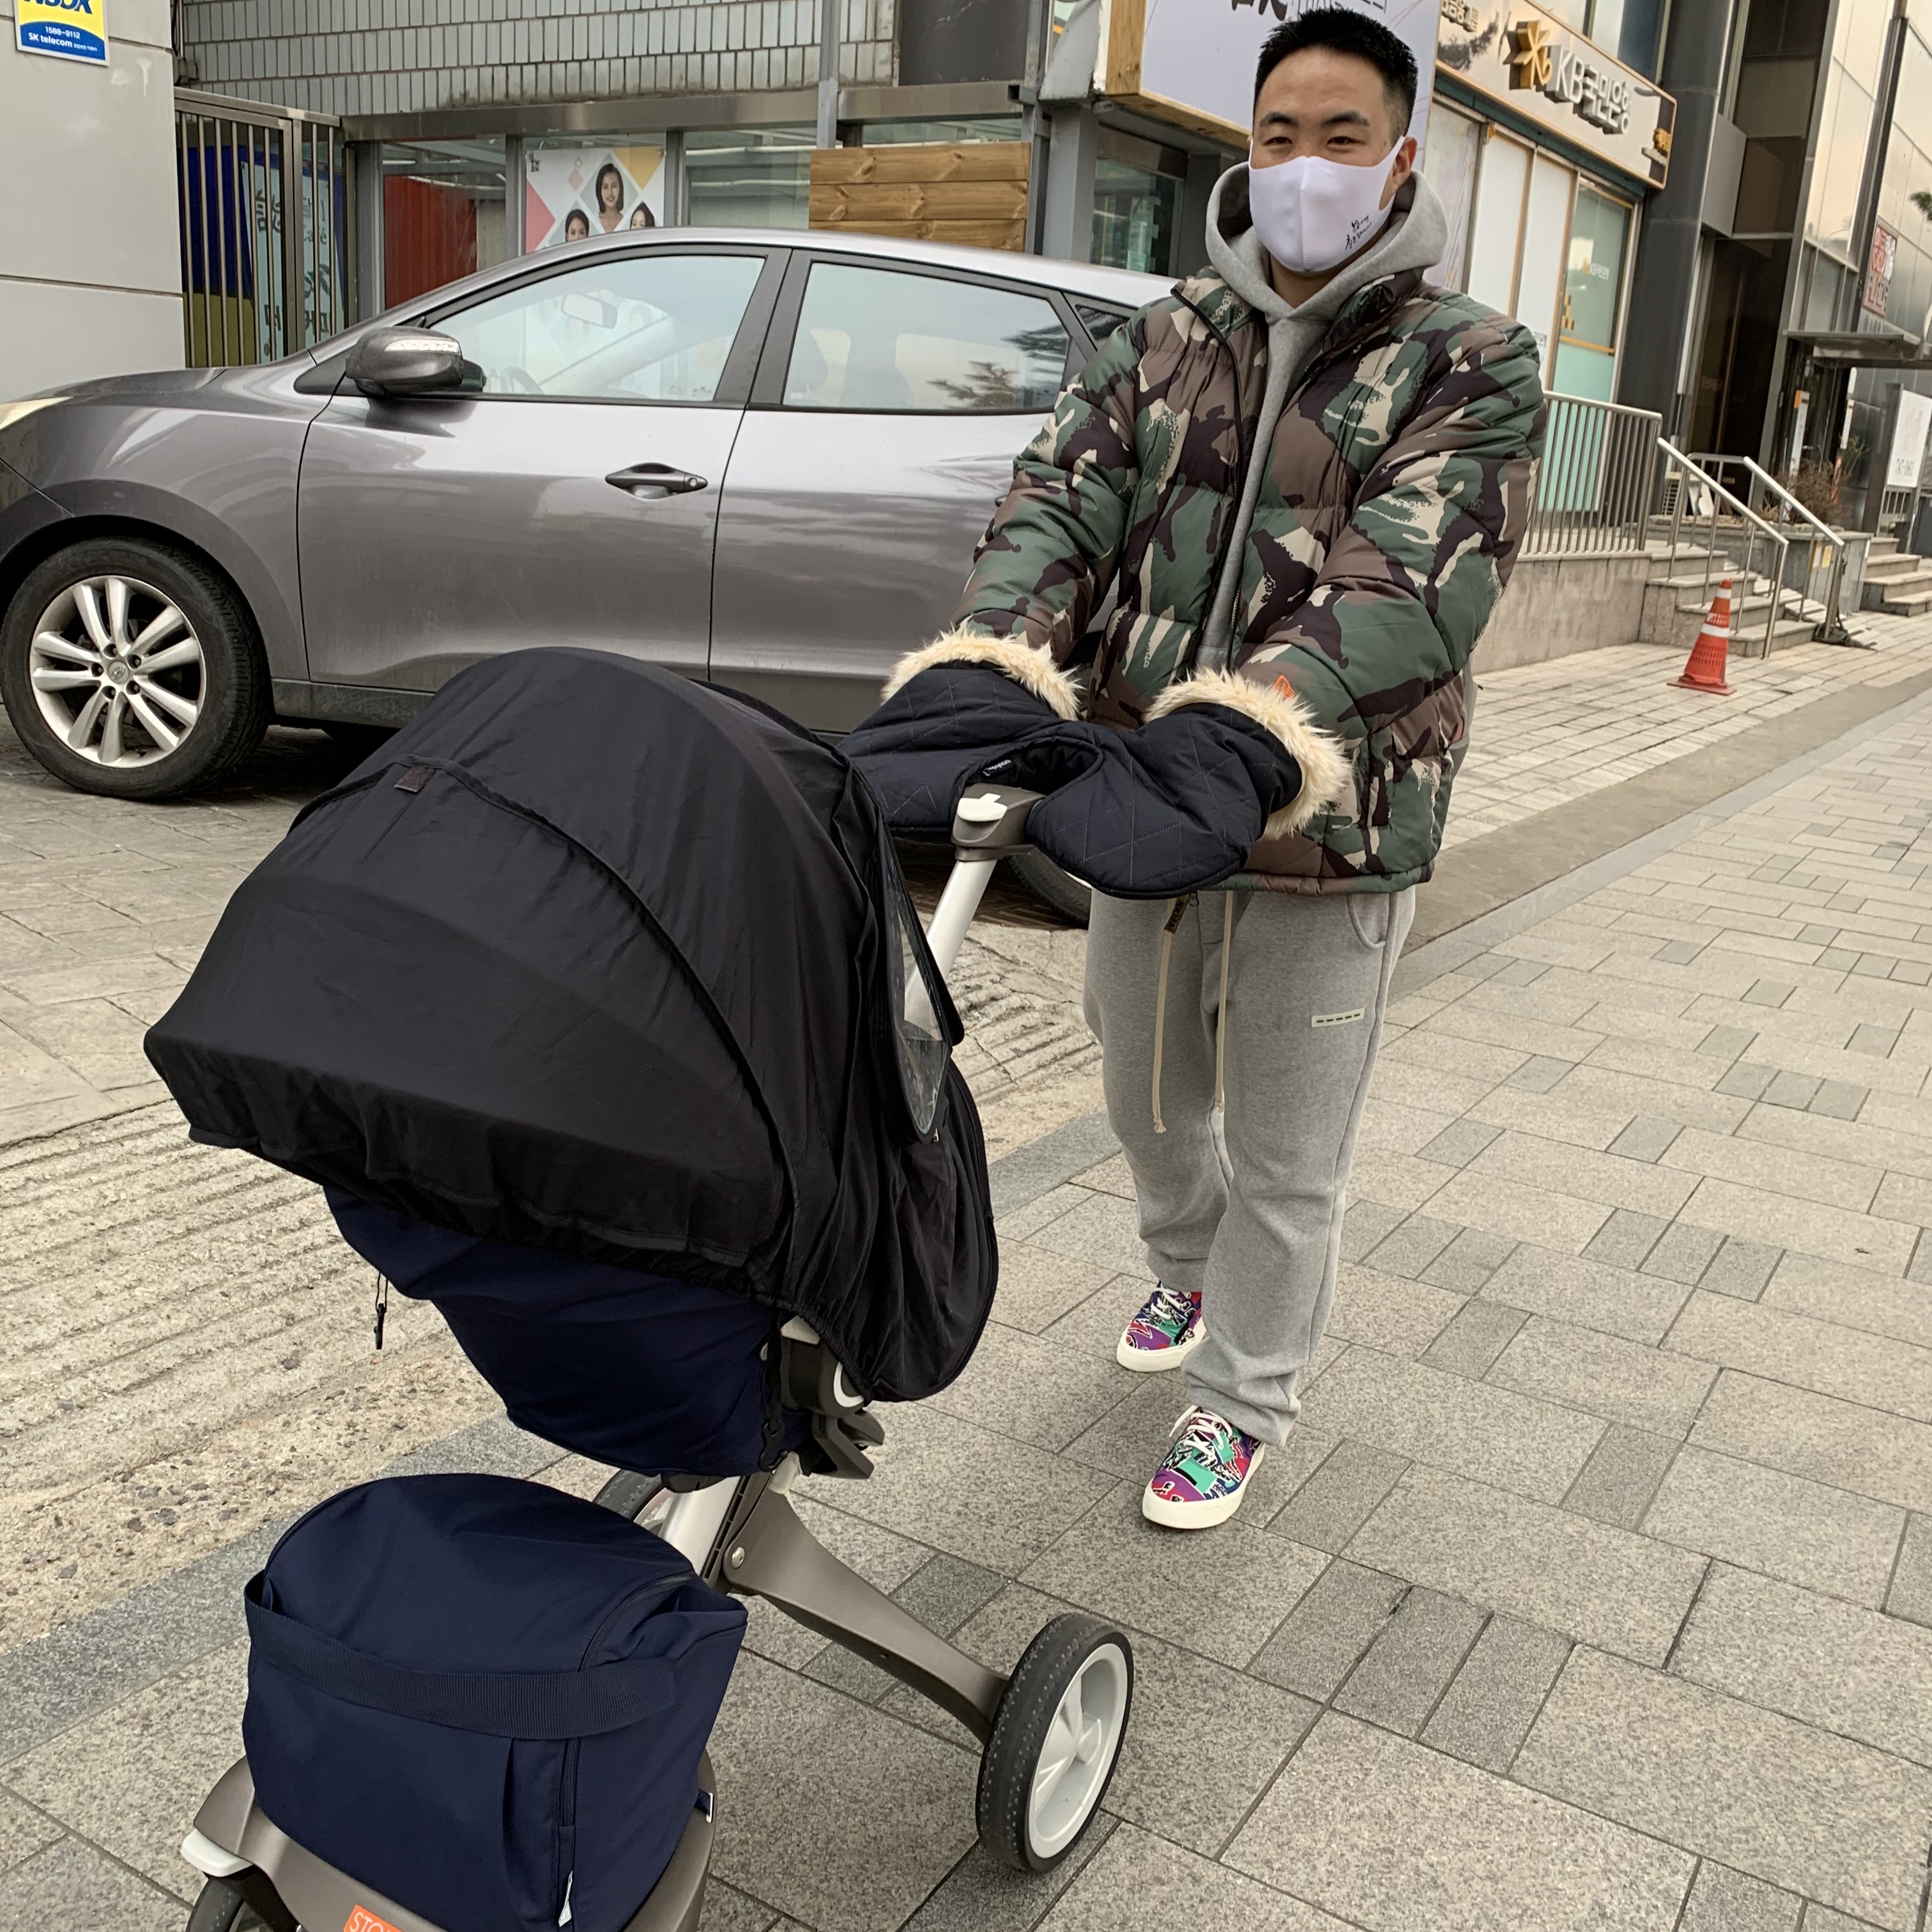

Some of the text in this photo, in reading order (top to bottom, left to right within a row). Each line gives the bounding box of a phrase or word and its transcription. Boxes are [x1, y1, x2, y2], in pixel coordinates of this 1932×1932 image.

[29, 33, 39, 42] SK
[40, 35, 72, 47] telecom
[45, 26, 80, 39] 1588-9112
[1556, 45, 1632, 134] KB국민은행
[349, 1912, 391, 1932] STO
